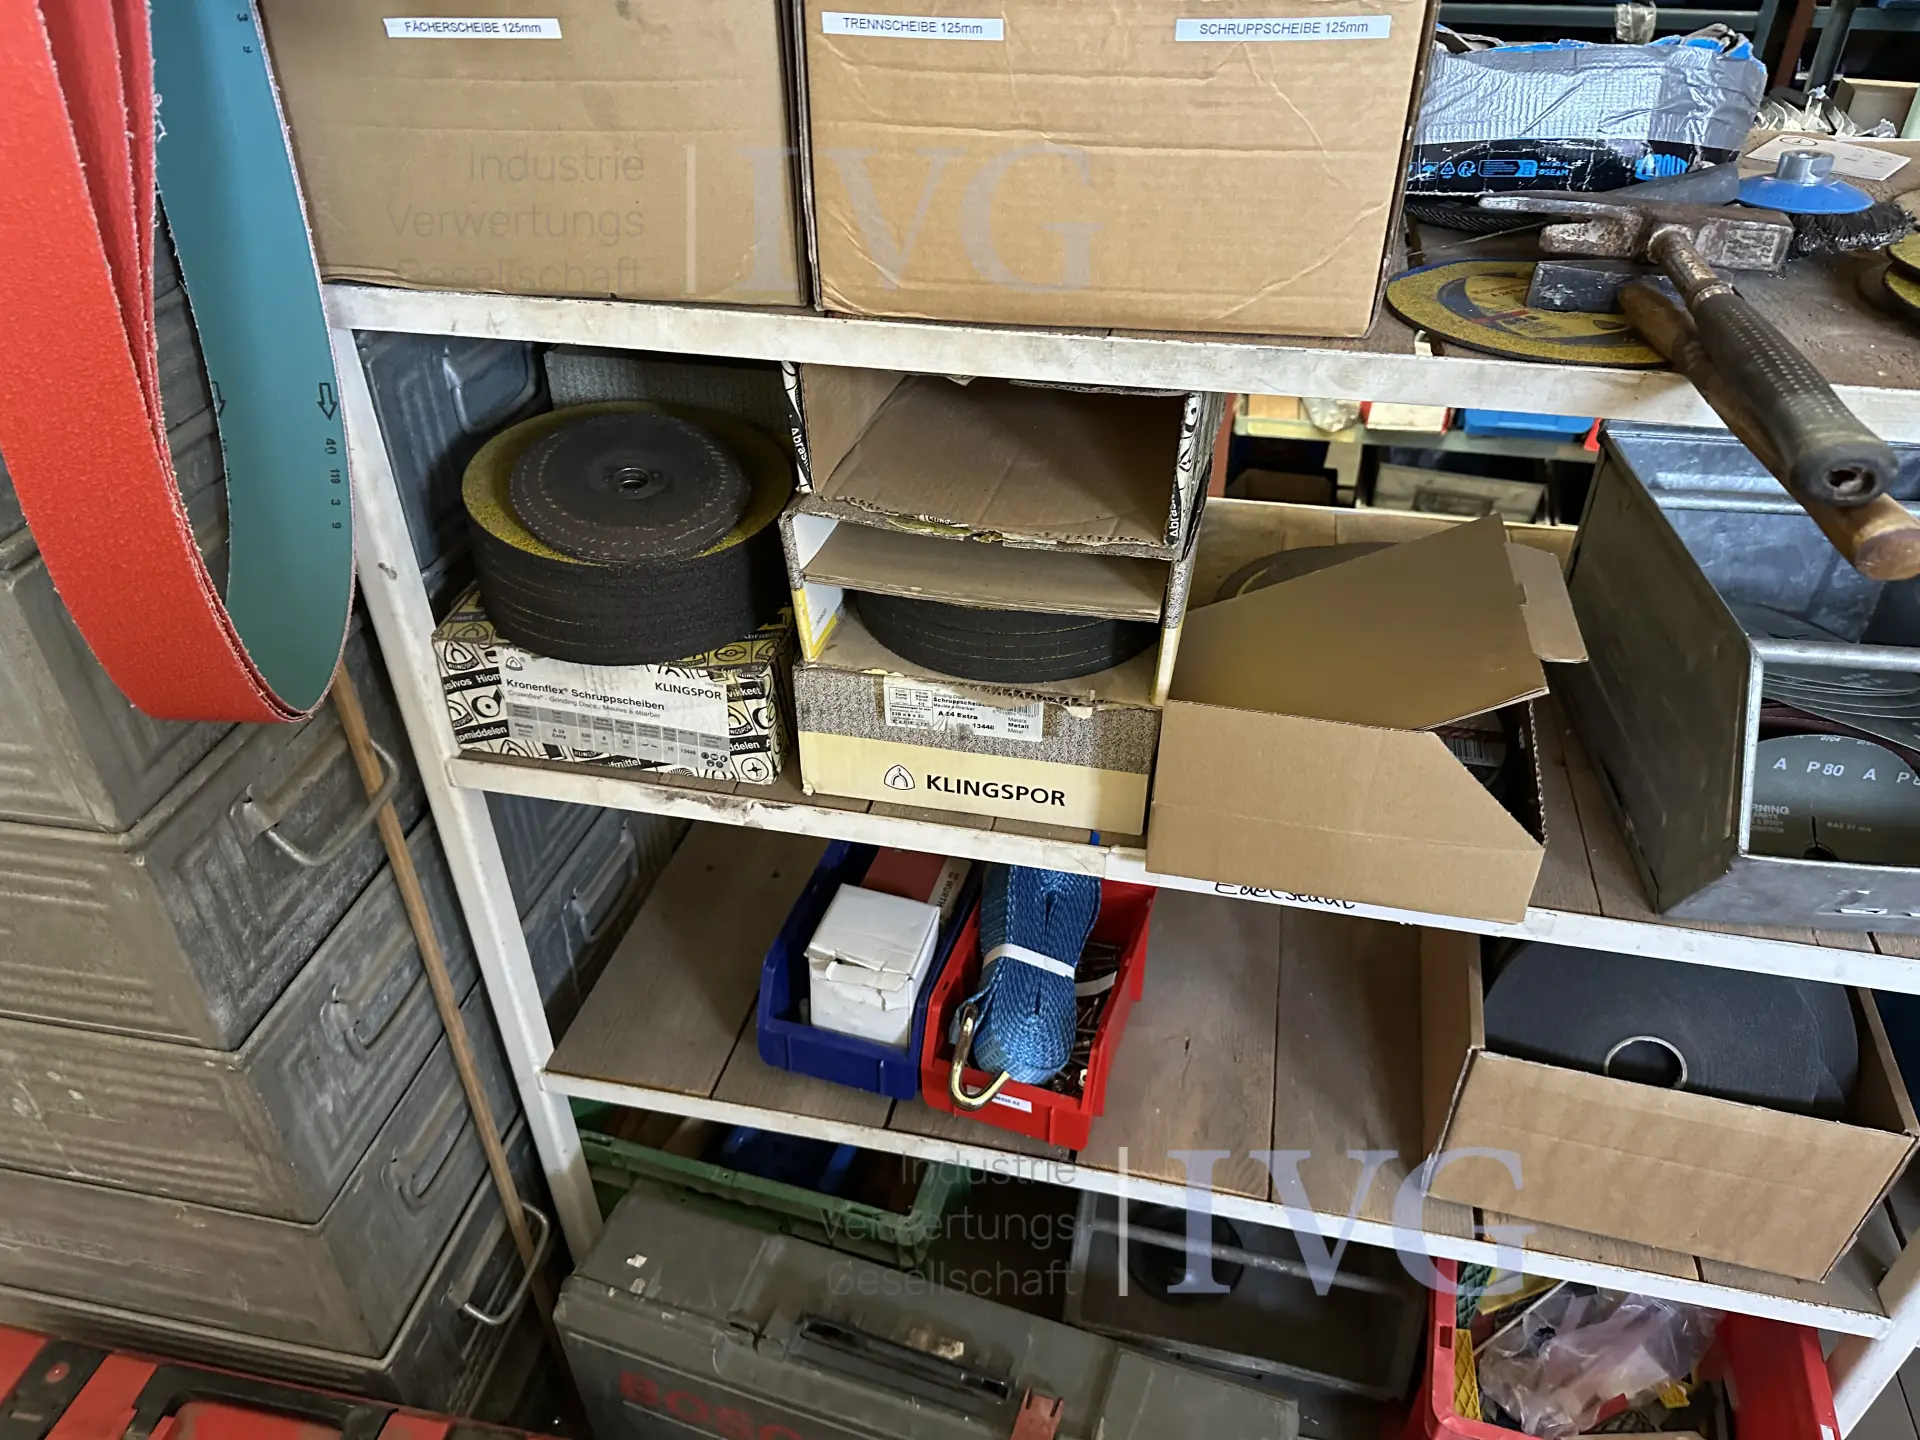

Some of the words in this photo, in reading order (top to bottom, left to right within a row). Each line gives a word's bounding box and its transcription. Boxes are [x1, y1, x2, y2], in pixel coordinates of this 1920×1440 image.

[404, 20, 500, 33] FÄCHERSCHEIBE
[503, 22, 542, 33] 125mm
[842, 17, 937, 33] TRENNSCHEIBE
[941, 22, 983, 34] 125mm
[1200, 23, 1321, 35] SCHRUPPSCHEIBE
[1325, 21, 1369, 33] 125mm
[324, 437, 337, 455] 40
[330, 498, 342, 506] 3
[571, 688, 665, 711] Schruppscheiben
[655, 682, 722, 701] KLINGSPOR
[956, 712, 979, 720] Extra
[1772, 757, 1788, 771] A
[1806, 760, 1820, 774] P
[1822, 763, 1845, 777] 80
[1862, 768, 1877, 781] A
[1896, 771, 1910, 784] P
[926, 773, 1067, 807] KLINGSPOR
